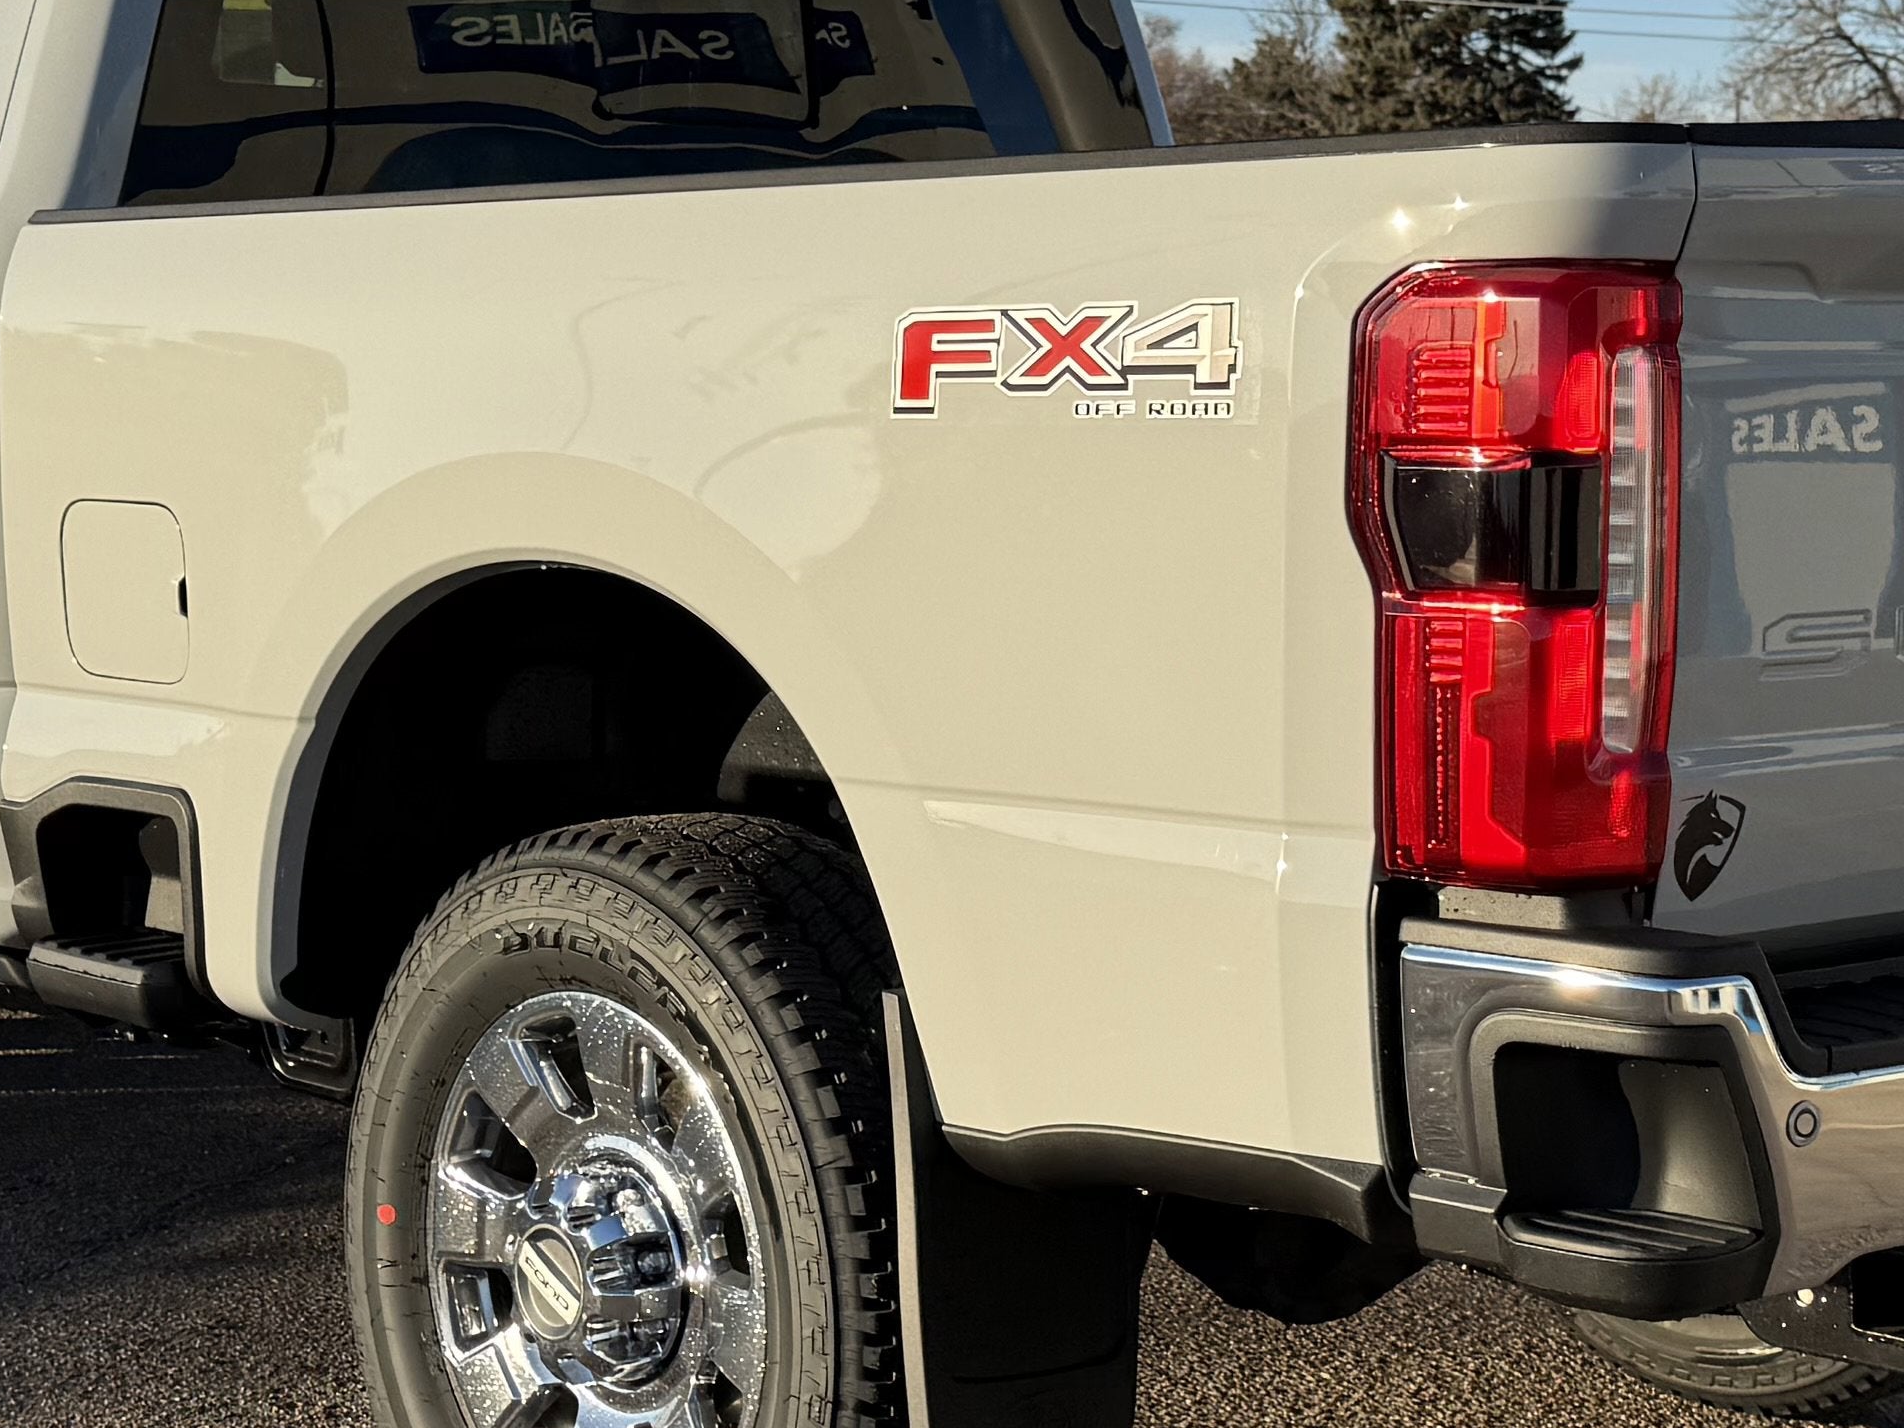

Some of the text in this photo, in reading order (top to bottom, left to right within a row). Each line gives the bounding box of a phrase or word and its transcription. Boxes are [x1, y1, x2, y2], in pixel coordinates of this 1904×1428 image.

[890, 297, 1243, 420] FX4
[1072, 400, 1234, 419] OFF ROAD
[524, 1255, 570, 1311] FORD
